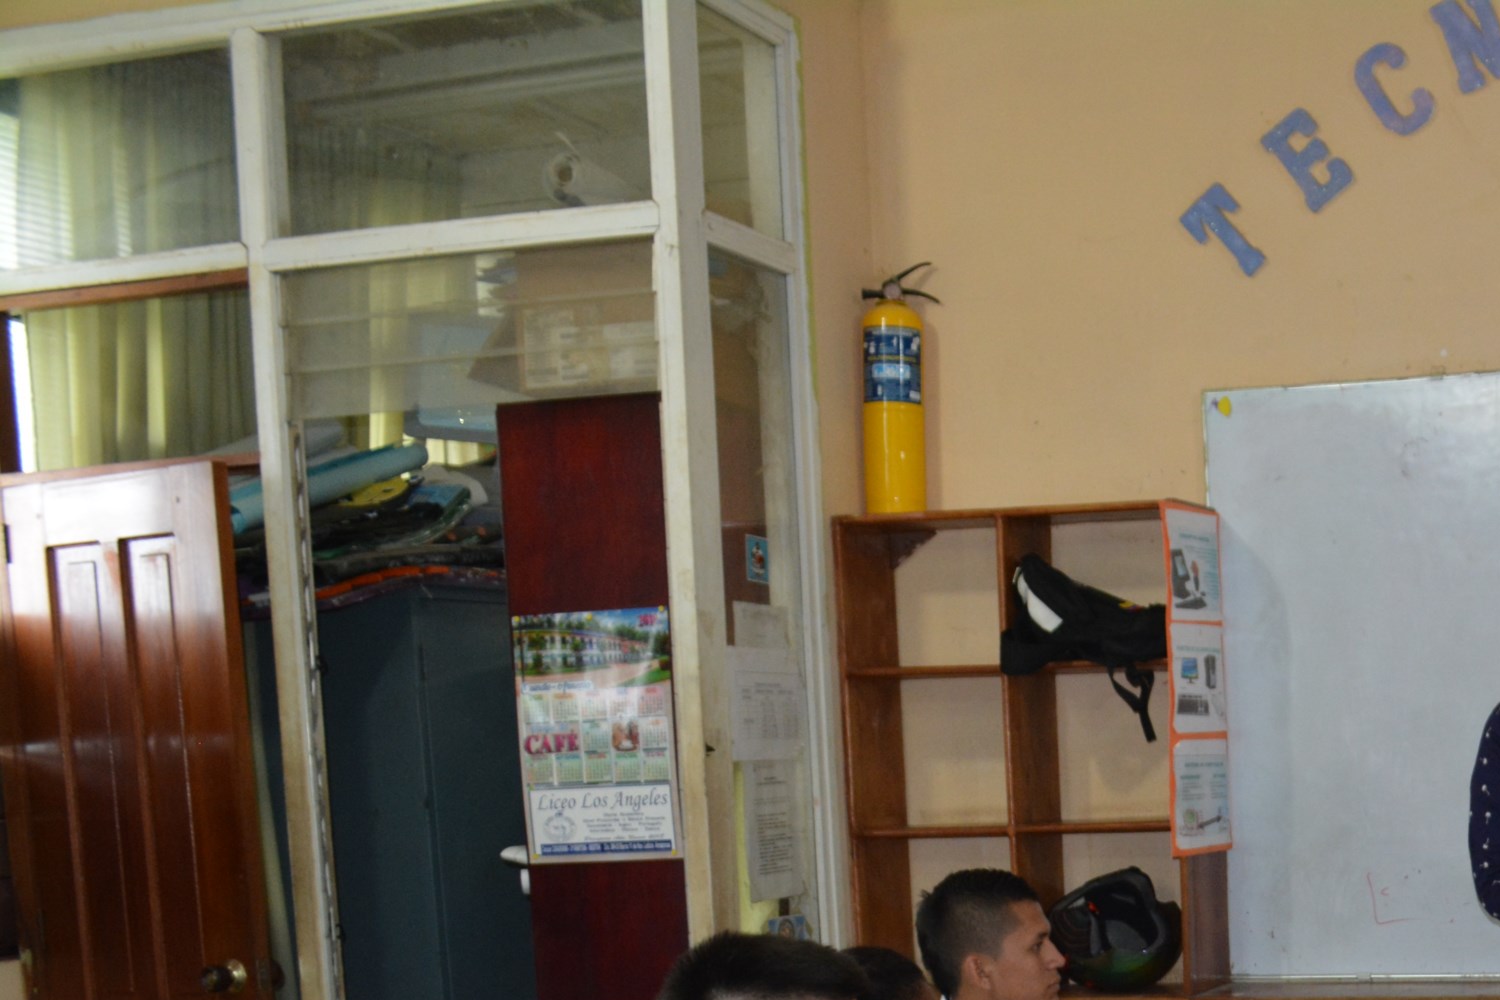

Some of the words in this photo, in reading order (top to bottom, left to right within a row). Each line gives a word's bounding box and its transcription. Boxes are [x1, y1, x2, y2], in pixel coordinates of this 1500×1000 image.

[537, 794, 577, 811] Liceo
[581, 792, 608, 809] Los
[611, 787, 668, 811] Angeles
